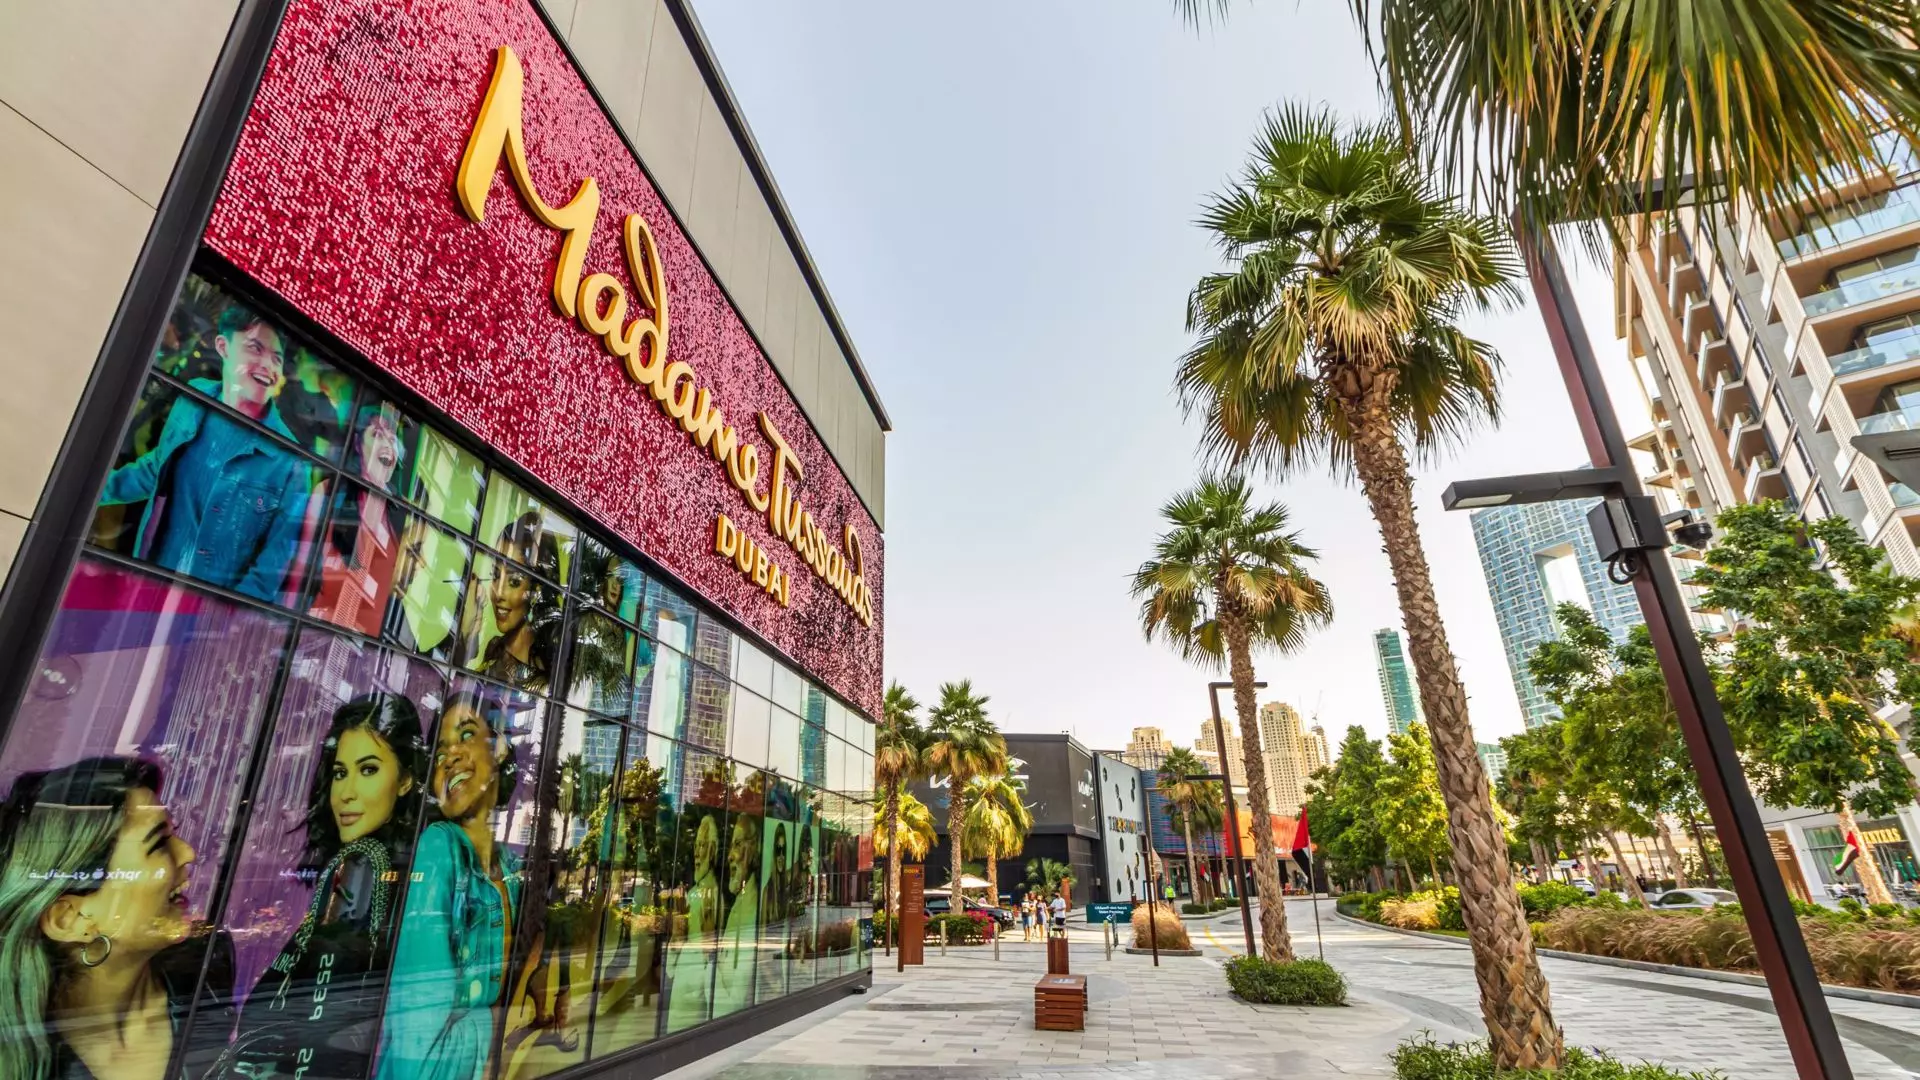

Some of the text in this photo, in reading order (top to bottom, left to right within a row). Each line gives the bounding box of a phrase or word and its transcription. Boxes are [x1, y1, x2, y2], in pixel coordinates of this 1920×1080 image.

[457, 45, 872, 627] Madame Tussauds
[716, 513, 789, 607] DUBAI
